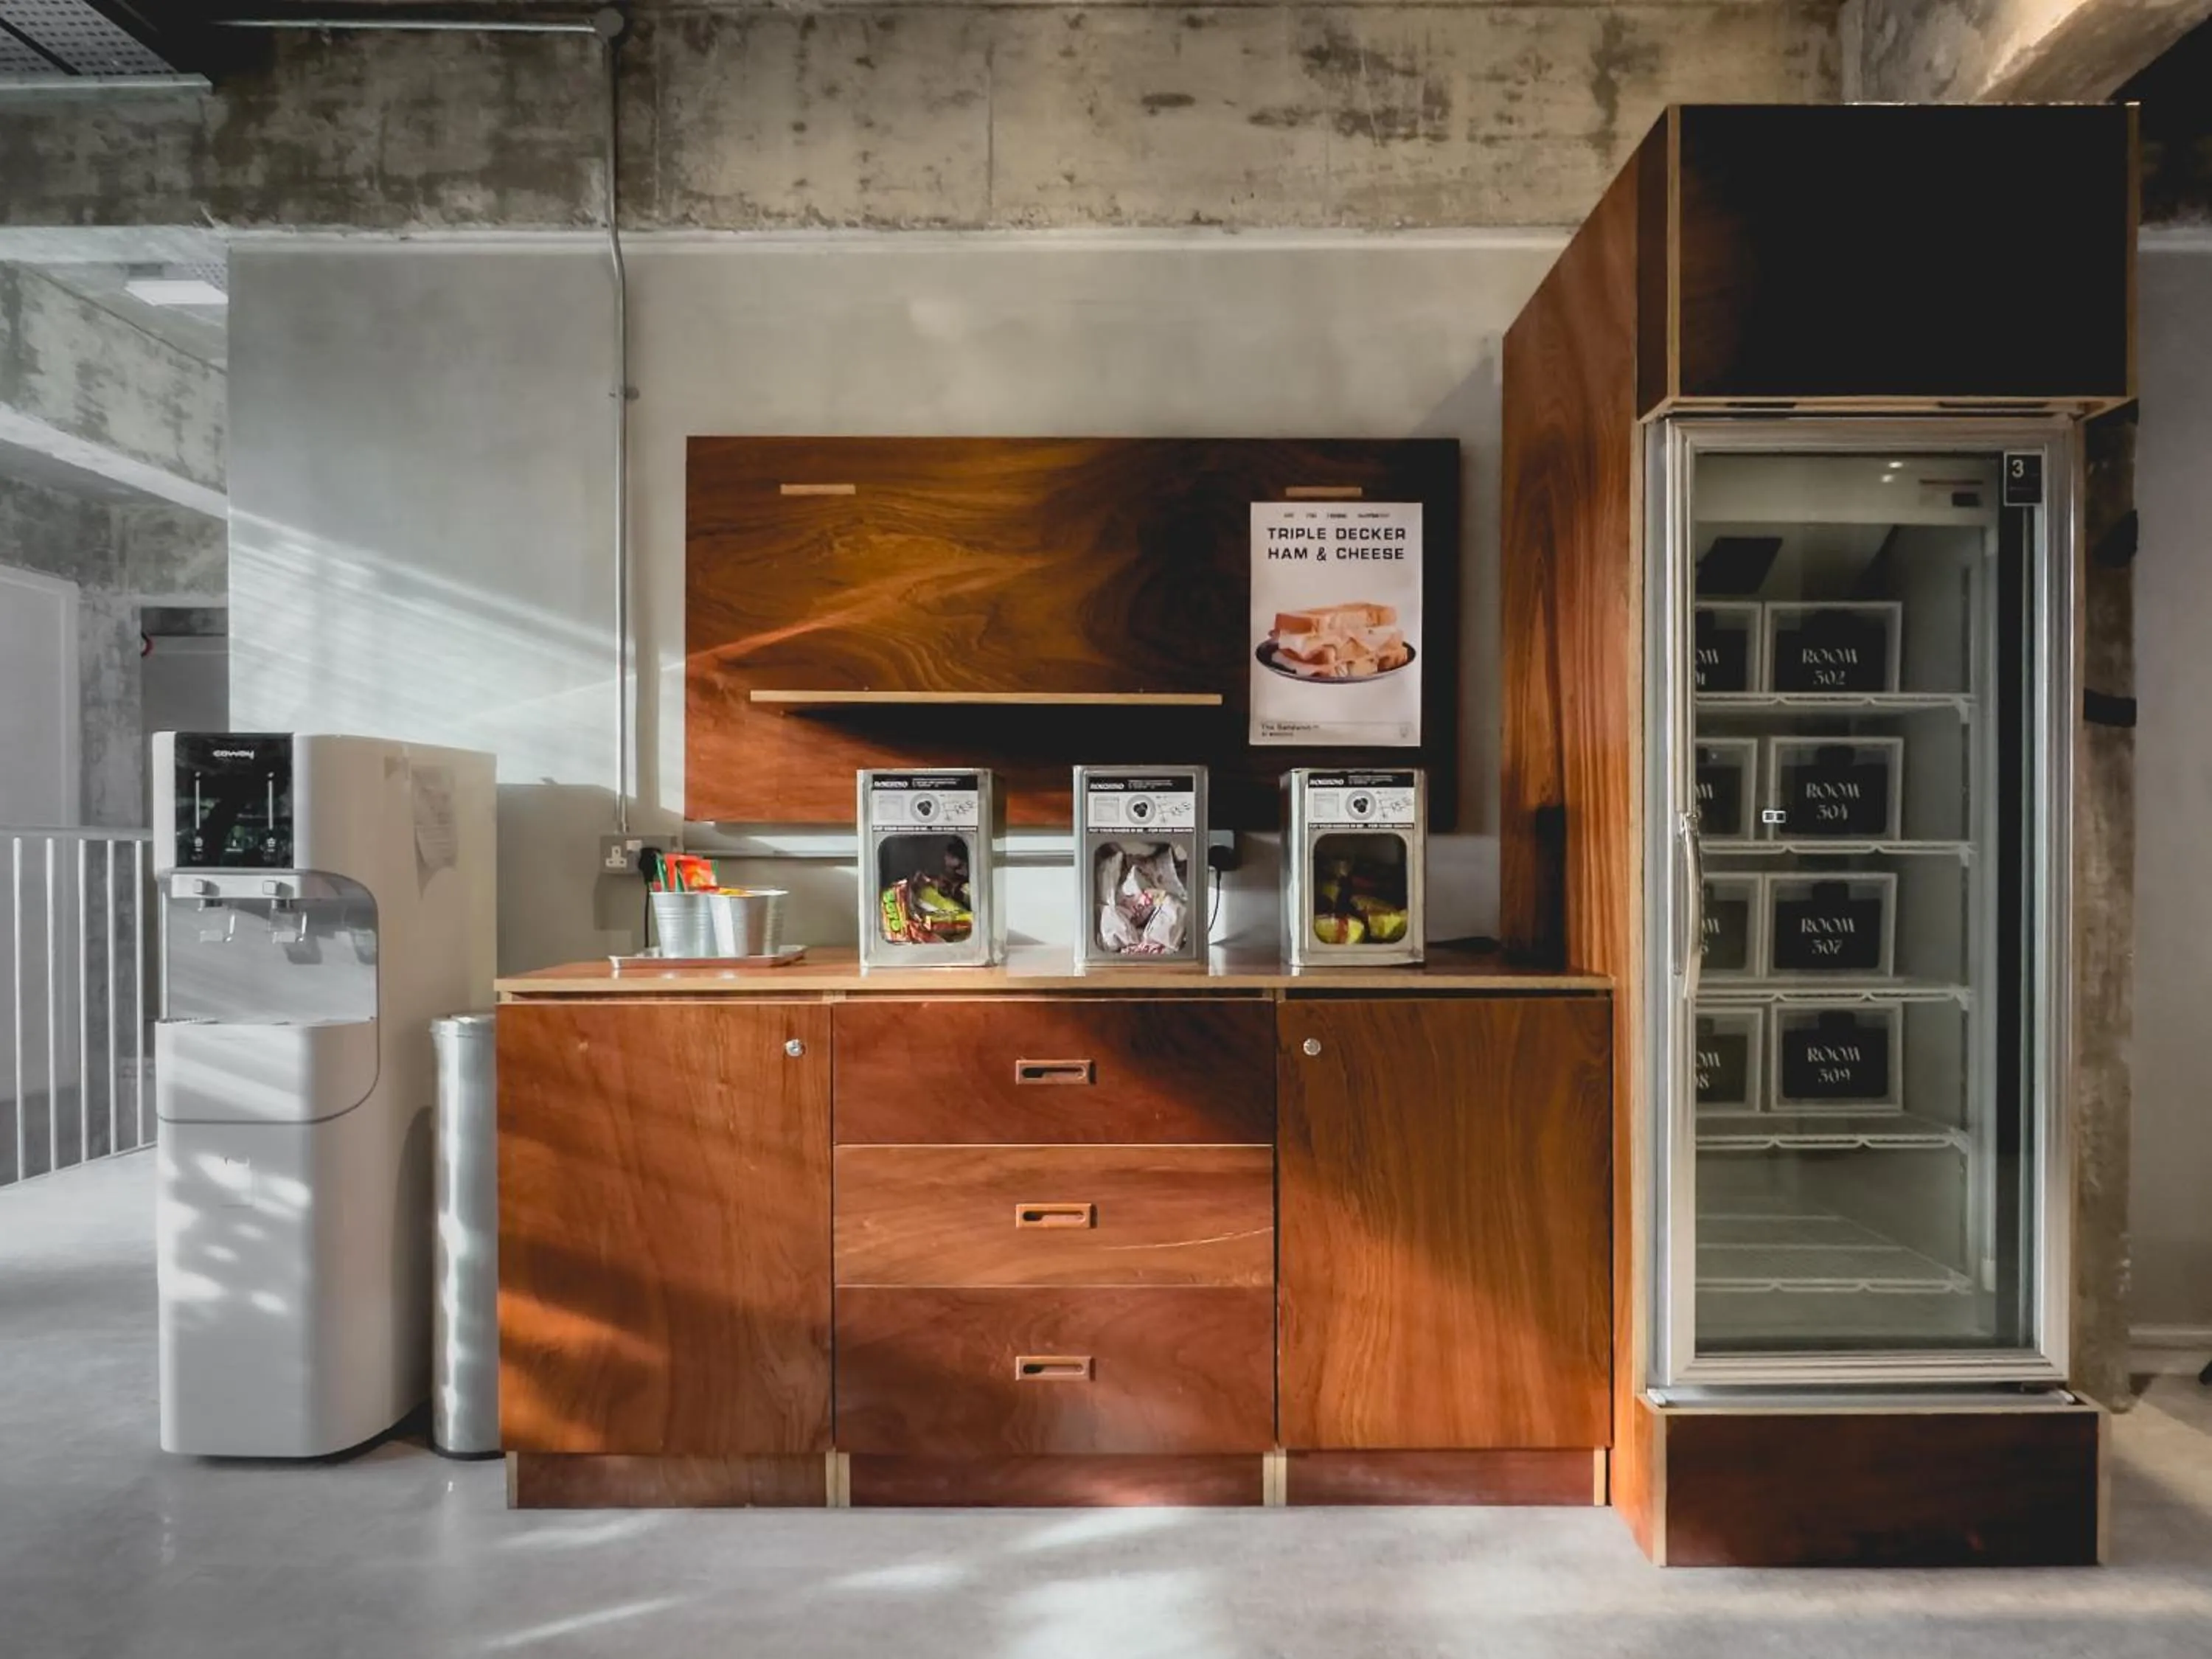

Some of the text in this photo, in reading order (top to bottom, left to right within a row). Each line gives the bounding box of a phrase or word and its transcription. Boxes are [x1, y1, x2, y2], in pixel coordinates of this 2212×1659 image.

[2011, 459, 2024, 479] 3
[1267, 527, 1406, 540] TRIPLE DECKER
[1267, 546, 1405, 562] HAM & CHEESE
[1802, 647, 1858, 664] ROOM
[1805, 782, 1861, 799] ROOM
[1801, 917, 1856, 933] ROOM
[1806, 1046, 1862, 1062] ROOM
